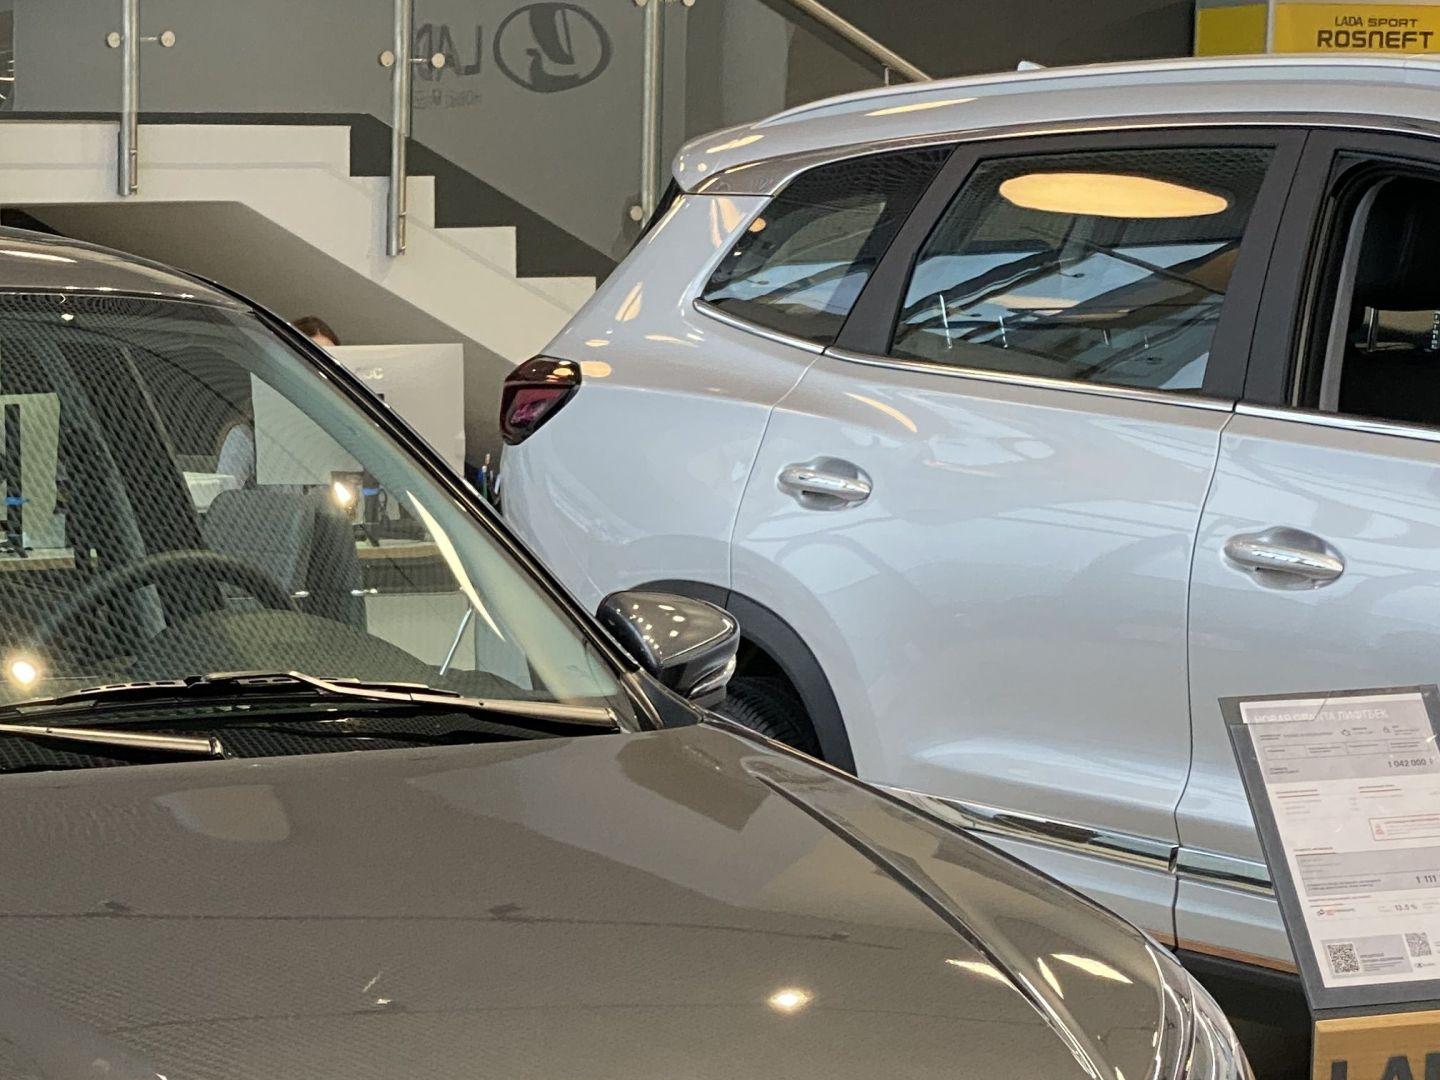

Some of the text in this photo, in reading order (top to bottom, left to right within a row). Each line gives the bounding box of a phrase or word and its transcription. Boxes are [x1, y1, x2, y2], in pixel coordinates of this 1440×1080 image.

[1334, 16, 1418, 28] LADA SPORT
[1317, 29, 1434, 49] ROSNEFT
